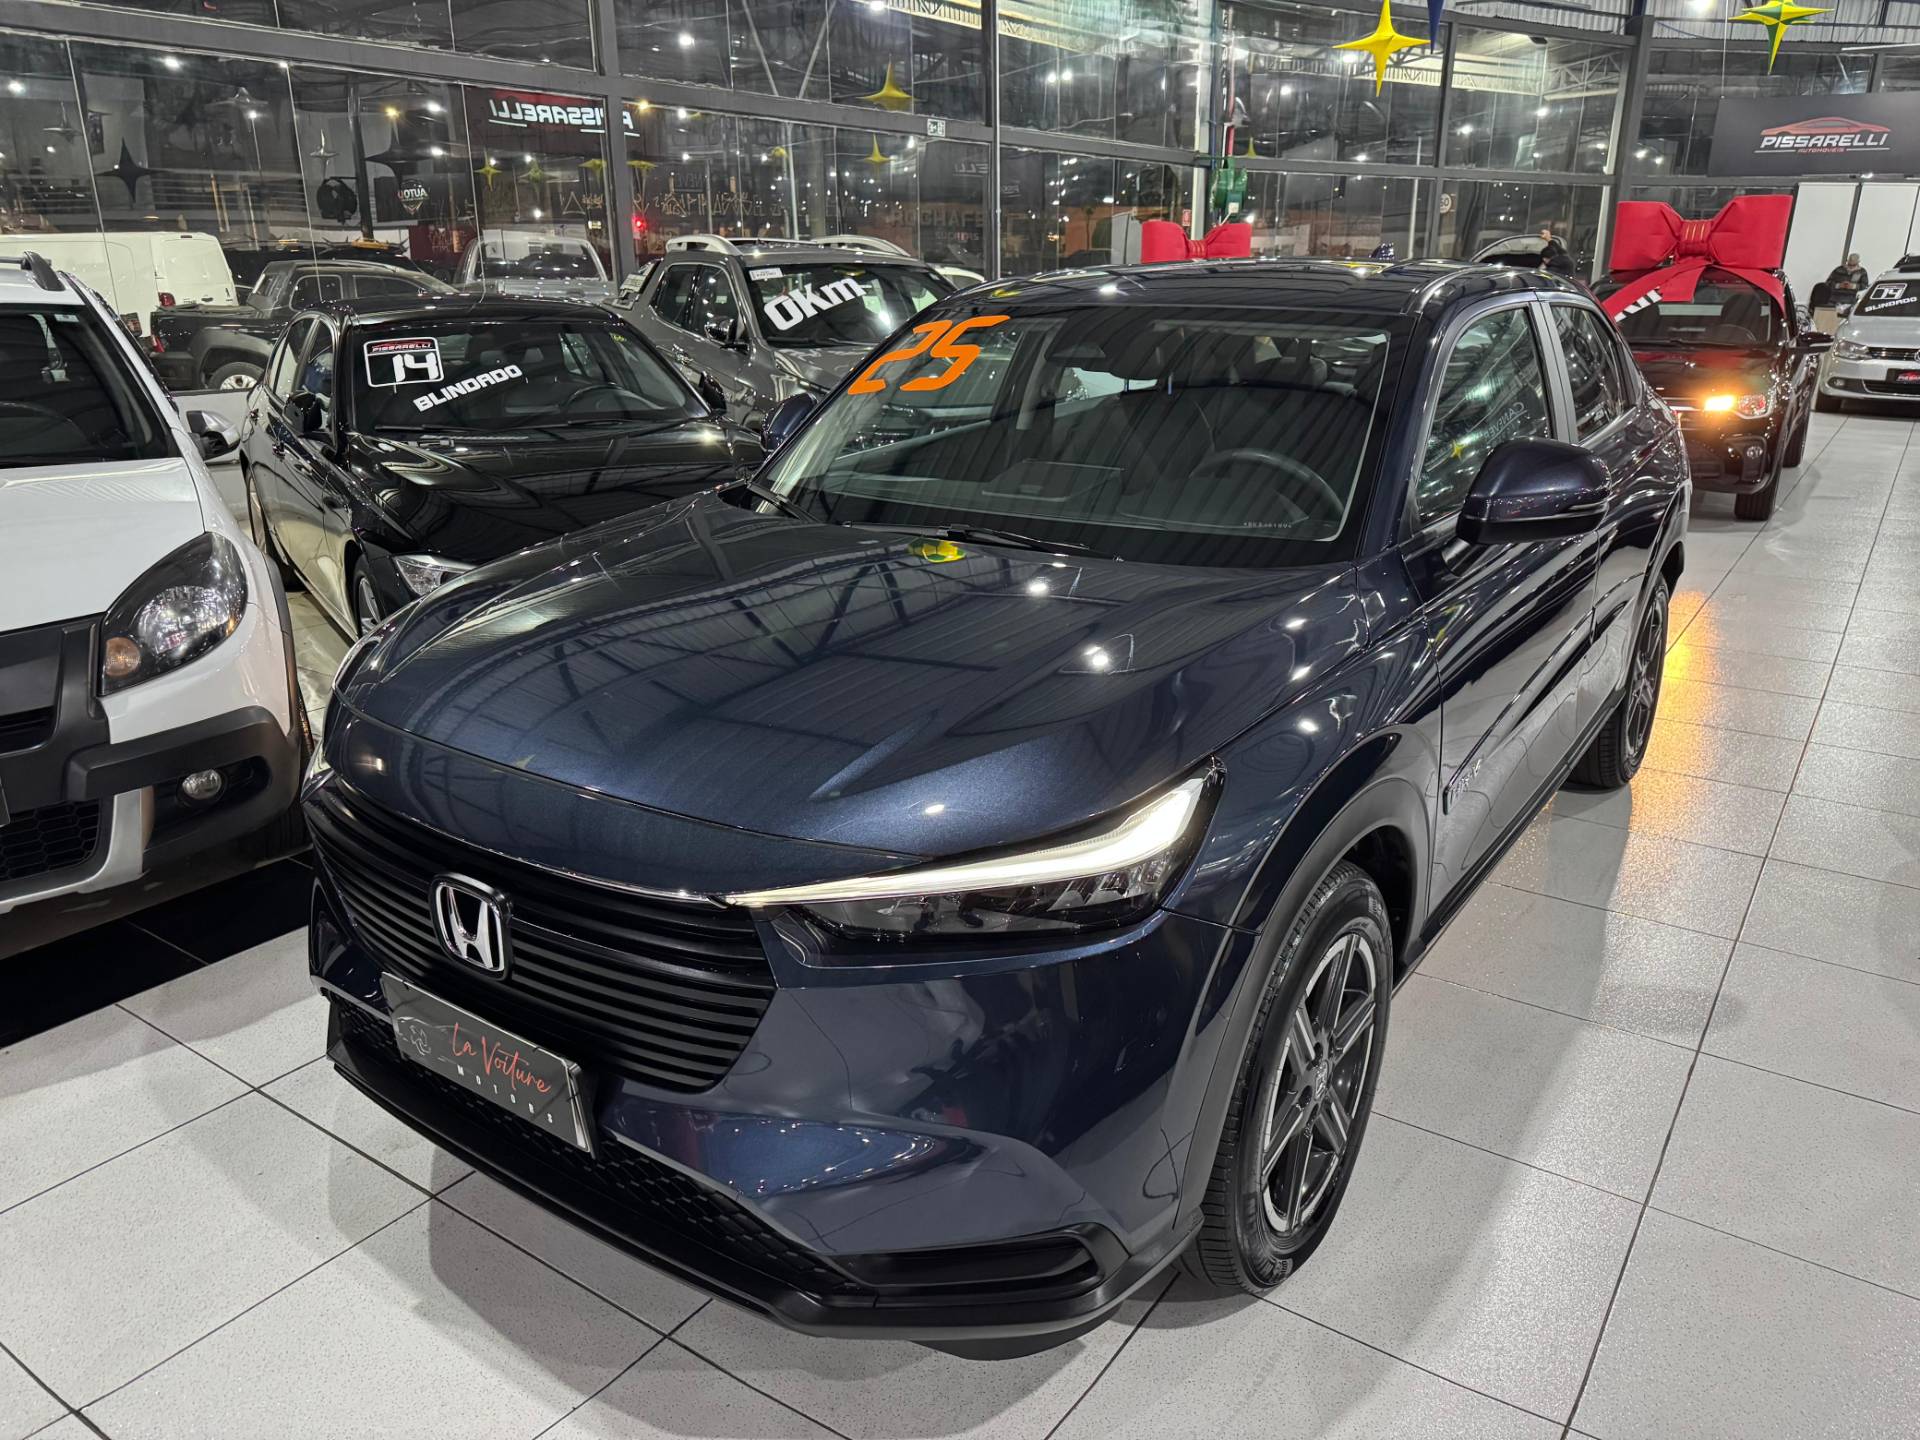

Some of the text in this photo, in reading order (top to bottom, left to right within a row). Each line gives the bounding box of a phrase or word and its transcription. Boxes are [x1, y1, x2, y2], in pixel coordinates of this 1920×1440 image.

[1760, 133, 1888, 148] PISSARELLI
[1864, 296, 1917, 312] BLINDADO
[392, 352, 440, 382] 14
[848, 315, 1011, 395] 25
[413, 364, 523, 412] BLINDADO
[452, 1022, 552, 1093] La Voiture
